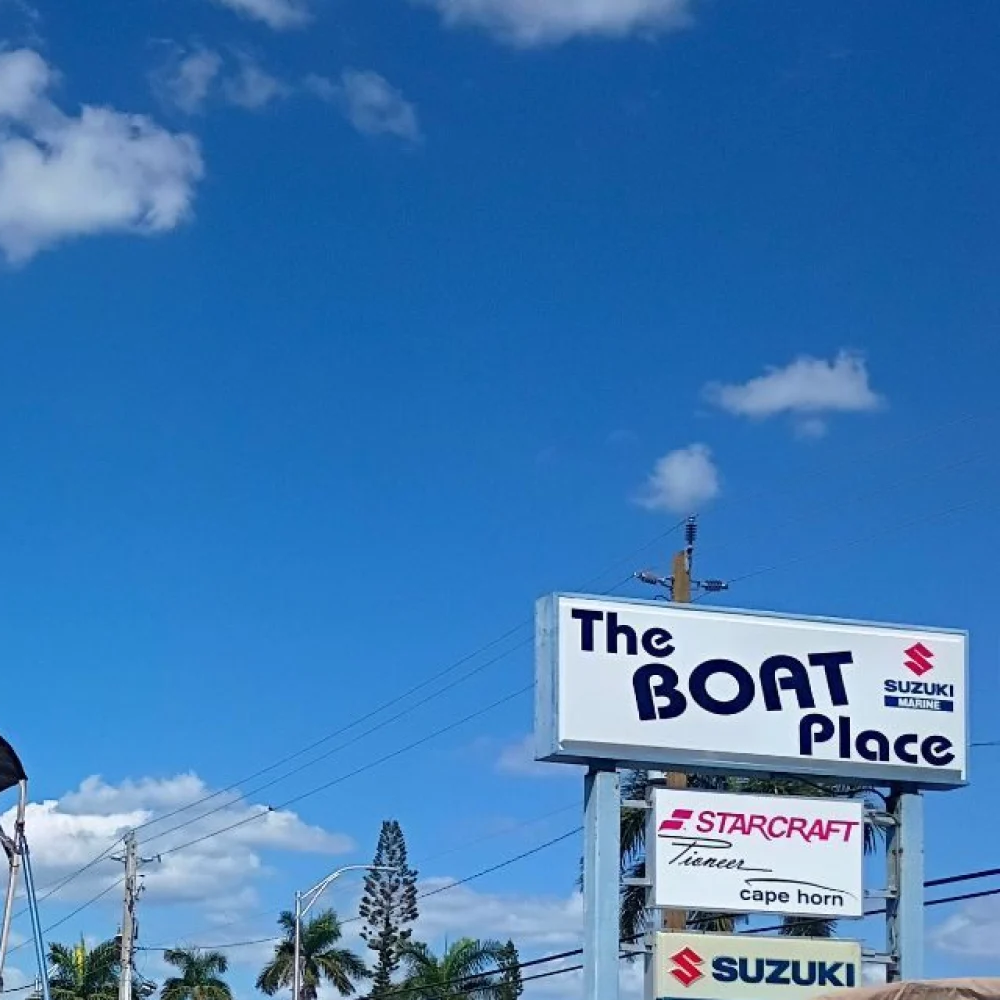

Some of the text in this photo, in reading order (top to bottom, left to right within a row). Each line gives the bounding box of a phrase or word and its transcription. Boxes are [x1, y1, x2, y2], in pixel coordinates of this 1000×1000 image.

[571, 608, 675, 657] The
[632, 650, 853, 721] BOAT
[884, 679, 954, 698] SUZUKI
[898, 697, 942, 710] MARINE
[799, 712, 955, 766] Place
[696, 810, 859, 843] STARCRAFT
[658, 833, 773, 872] Pioneer
[739, 888, 844, 907] cape horn
[711, 956, 855, 988] SUZUKI
